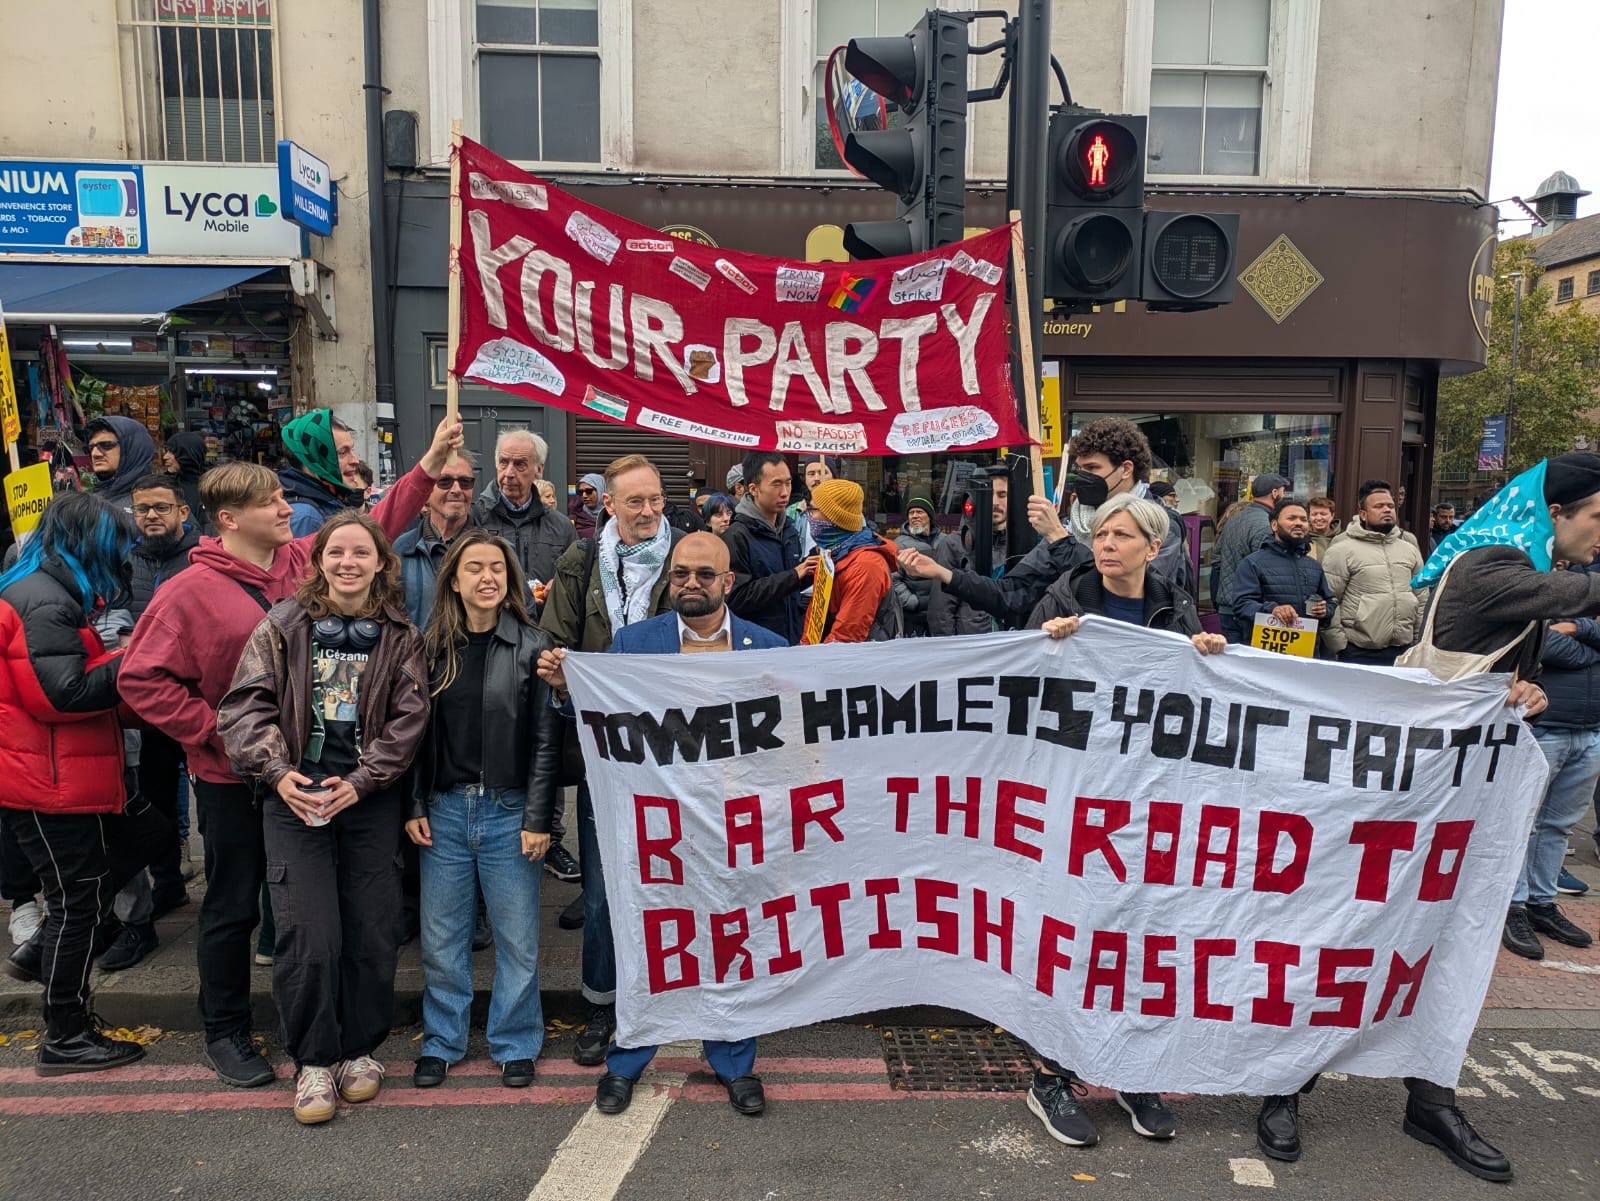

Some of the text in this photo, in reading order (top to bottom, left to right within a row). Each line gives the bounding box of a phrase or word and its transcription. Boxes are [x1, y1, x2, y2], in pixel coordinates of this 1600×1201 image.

[298, 159, 316, 181] Lyca
[82, 182, 112, 192] oyster
[0, 203, 72, 211] NVENIENCE STORE
[164, 185, 249, 222] Lyca
[294, 193, 329, 224] MILLENIUM
[27, 215, 67, 223] TOBACCO
[203, 219, 249, 232] Mobile
[783, 270, 820, 282] TRANS
[786, 290, 819, 300] NOW
[468, 209, 997, 415] YOUR PARTY
[1043, 320, 1092, 338] tionery
[493, 346, 545, 366] SYSTEM
[515, 368, 562, 386] CLIMATE
[651, 413, 753, 443] FREE PALESTINE
[782, 426, 803, 439] NO
[817, 426, 866, 440] FASCISM
[902, 411, 978, 437] REFUGEES
[906, 423, 986, 447] WELCOME
[782, 441, 802, 450] NO
[814, 442, 856, 450] RACISM
[12, 483, 28, 501] STOP
[1262, 627, 1300, 643] STOP
[325, 648, 369, 663] Cézann
[1260, 640, 1289, 654] THE
[580, 676, 1520, 791] TOWER HAMLETS YOUR PARTY
[633, 775, 1476, 903] BAR THE ROAD TO
[642, 877, 1434, 1029] BRITISH FASCISM
